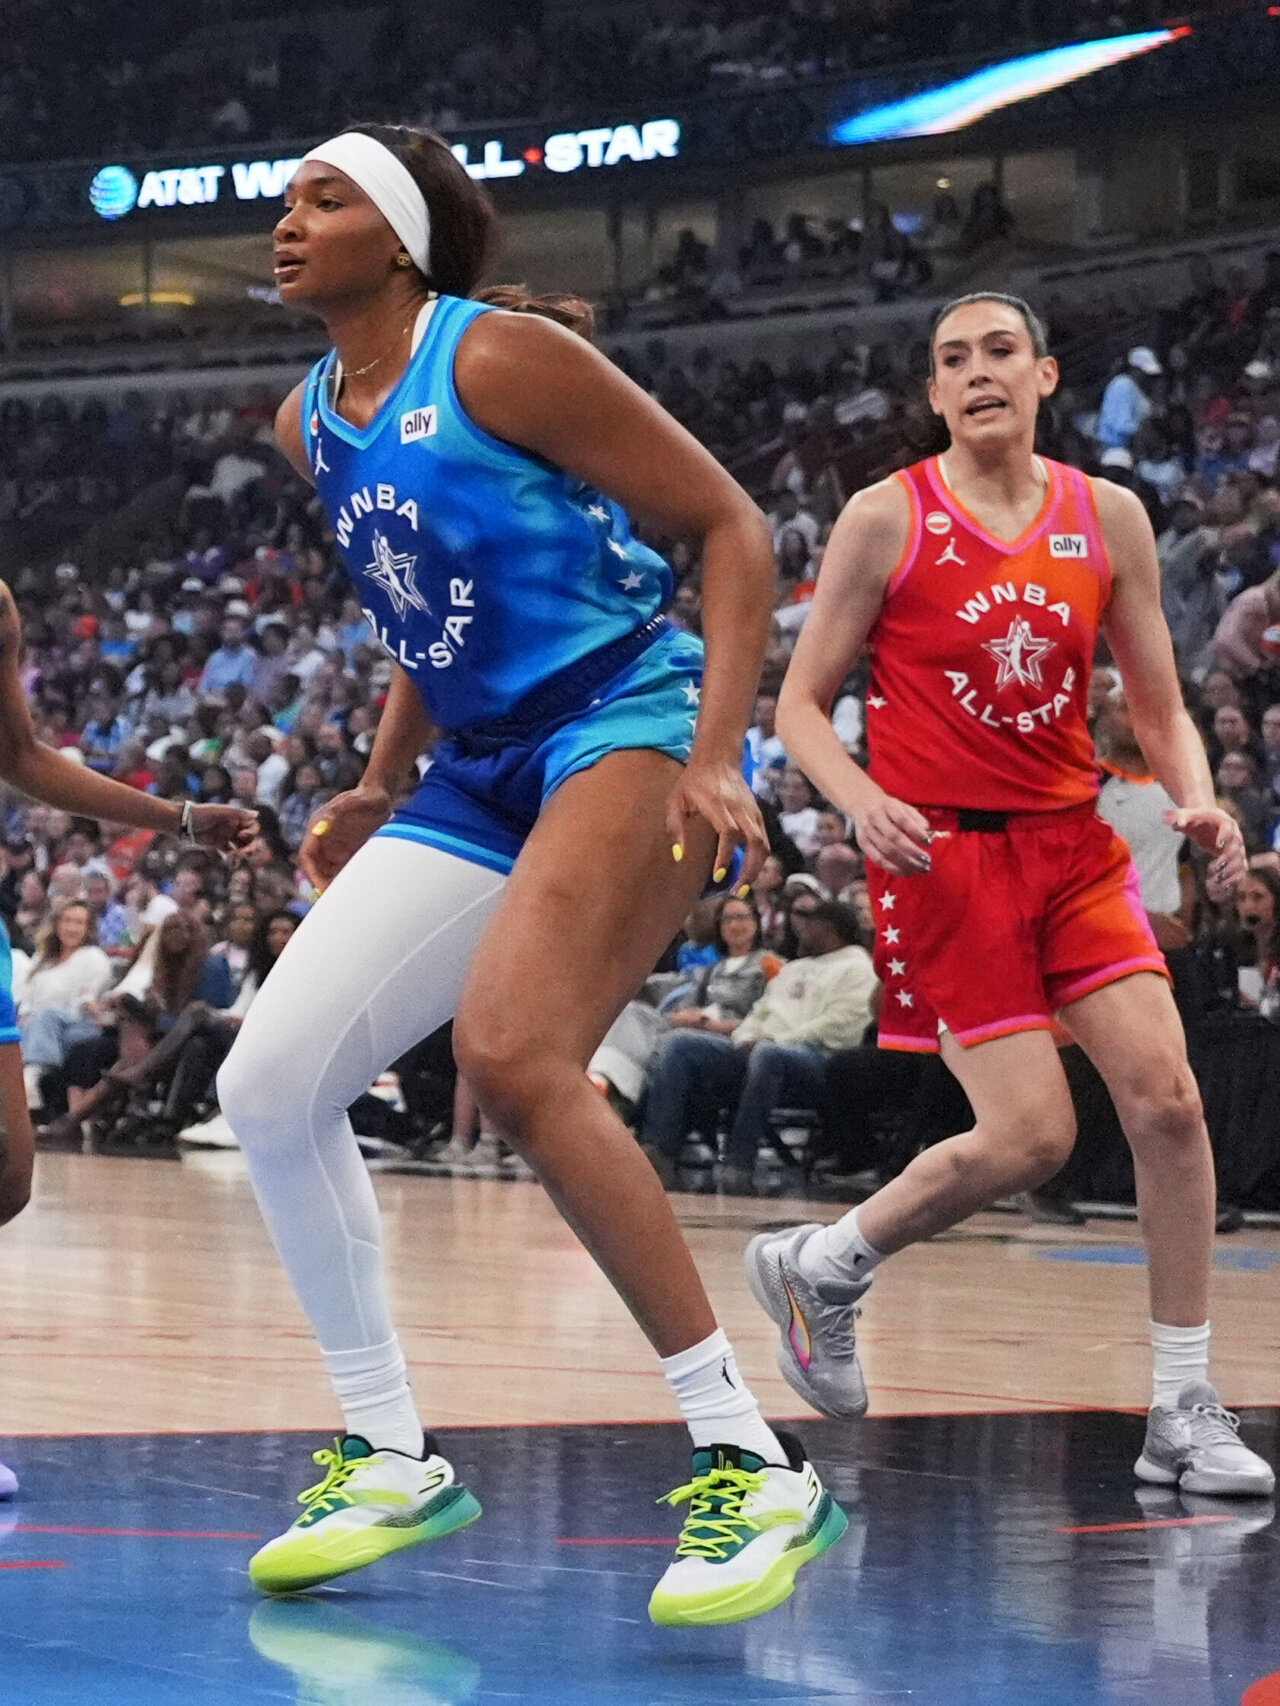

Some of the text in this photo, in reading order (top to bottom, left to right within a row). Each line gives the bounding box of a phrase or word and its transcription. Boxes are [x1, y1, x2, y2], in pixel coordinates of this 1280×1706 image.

[136, 165, 226, 209] AT&T
[451, 141, 526, 180] LL
[404, 412, 433, 435] ally
[336, 483, 419, 549] WNBA
[1053, 537, 1082, 555] ally
[955, 581, 1071, 627] WNBA
[943, 666, 1077, 734] ALL-STAR
